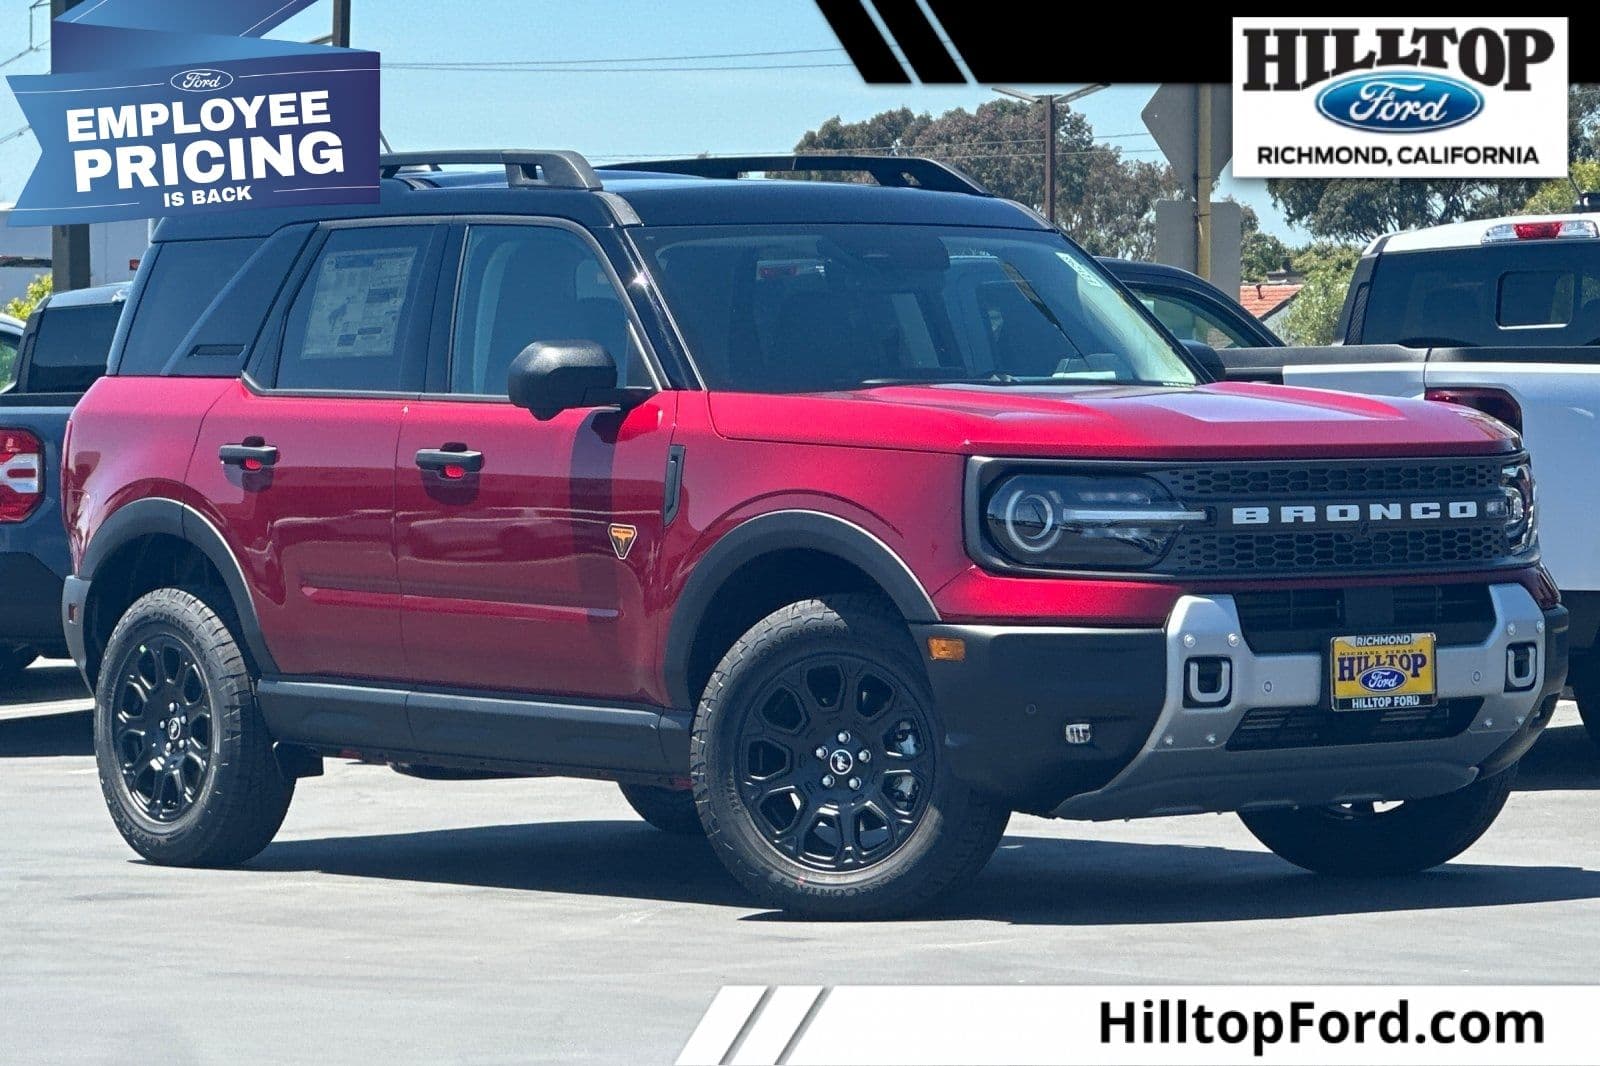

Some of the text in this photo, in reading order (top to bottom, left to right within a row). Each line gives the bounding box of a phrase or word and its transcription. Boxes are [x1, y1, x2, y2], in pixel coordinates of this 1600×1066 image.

[1232, 501, 1478, 524] BRONCO
[1356, 635, 1411, 647] RICHMOND
[1338, 653, 1427, 681] HILLTOP
[1368, 671, 1398, 688] Ford
[1352, 695, 1420, 709] HILLTOP FORD
